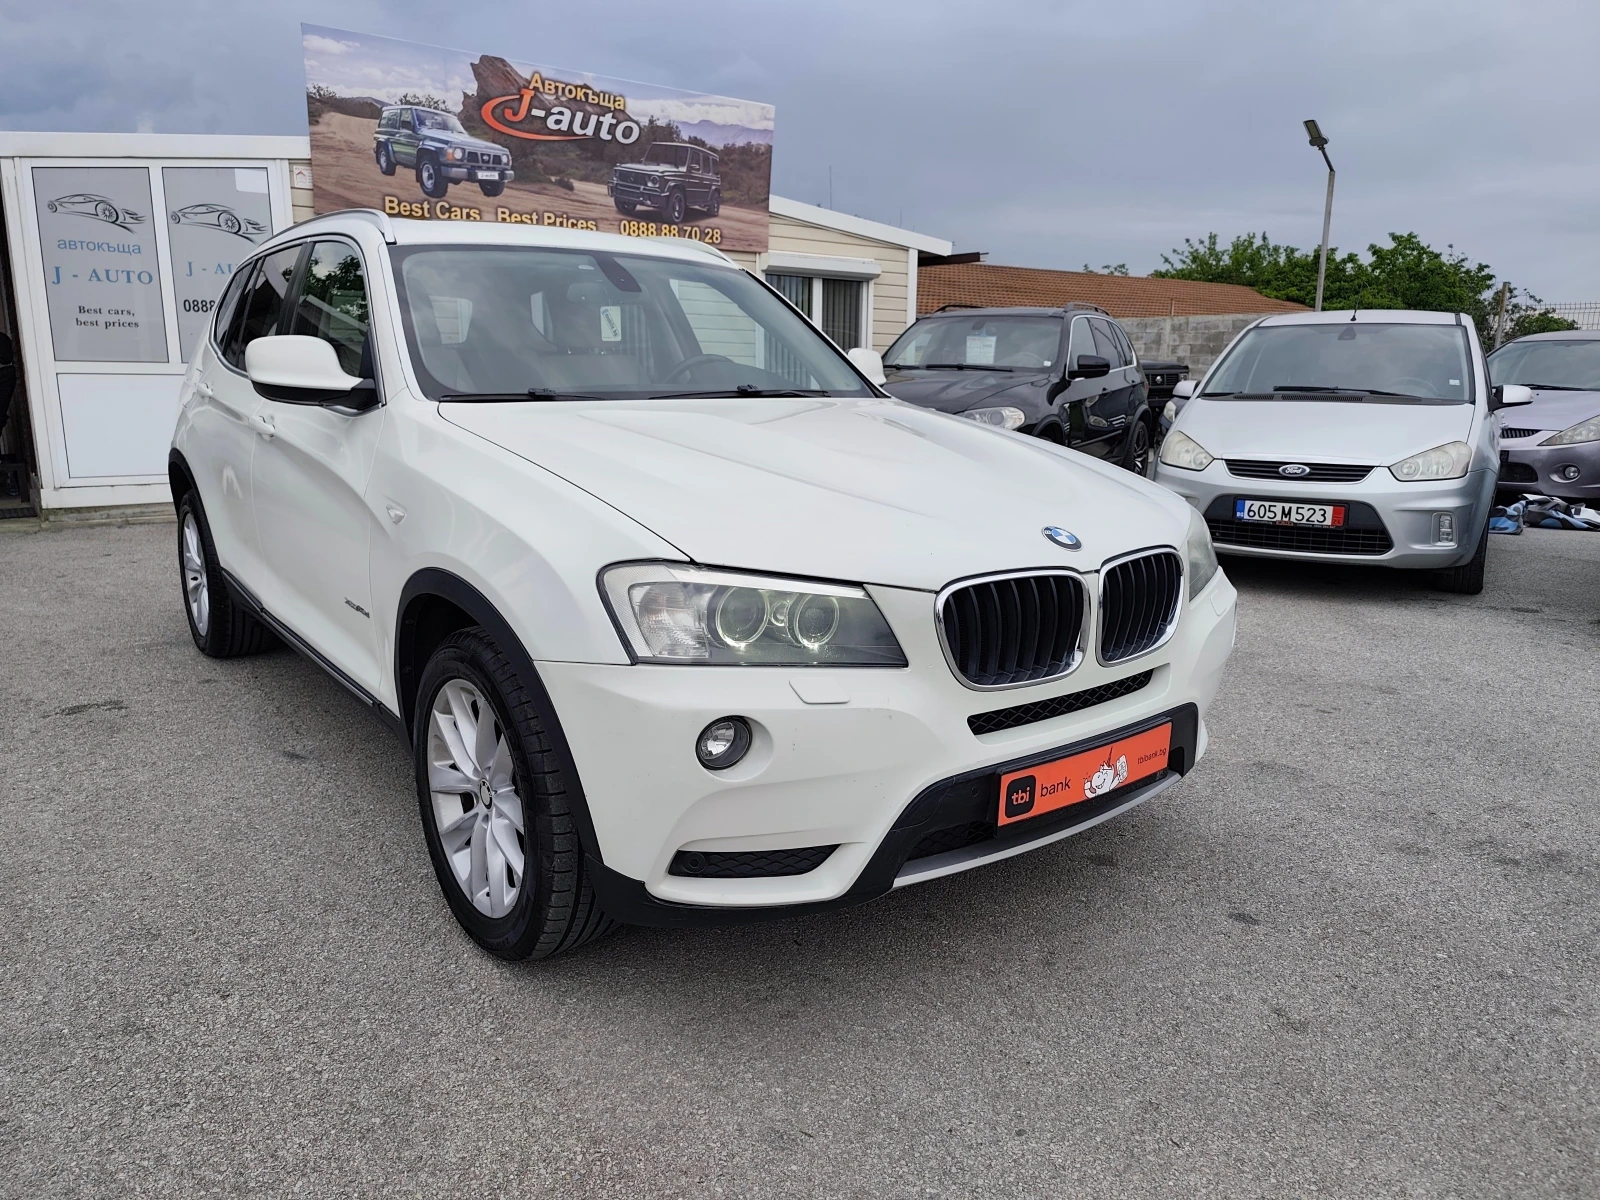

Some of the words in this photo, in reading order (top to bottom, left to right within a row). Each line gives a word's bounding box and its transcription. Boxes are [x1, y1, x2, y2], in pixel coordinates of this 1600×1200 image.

[528, 73, 625, 111] Автокъща
[503, 88, 640, 145] J-auto
[384, 196, 430, 218] Best
[435, 201, 481, 220] Cars
[497, 207, 538, 224] Best
[543, 212, 597, 232] Prices
[620, 220, 657, 237] 0888
[661, 224, 679, 238] 88
[683, 226, 700, 241] 70
[704, 228, 721, 244] 28
[57, 239, 142, 256] автокъща
[52, 266, 62, 285] J
[88, 268, 153, 285] AUTO
[186, 261, 193, 277] J
[78, 305, 102, 315] Best
[107, 308, 135, 317] cars,
[75, 318, 99, 327] best
[104, 319, 139, 330] prices
[1285, 466, 1303, 474] Ford
[1137, 747, 1167, 765] tbibank.bg
[1011, 786, 1031, 805] tbi
[1040, 776, 1072, 798] bank
